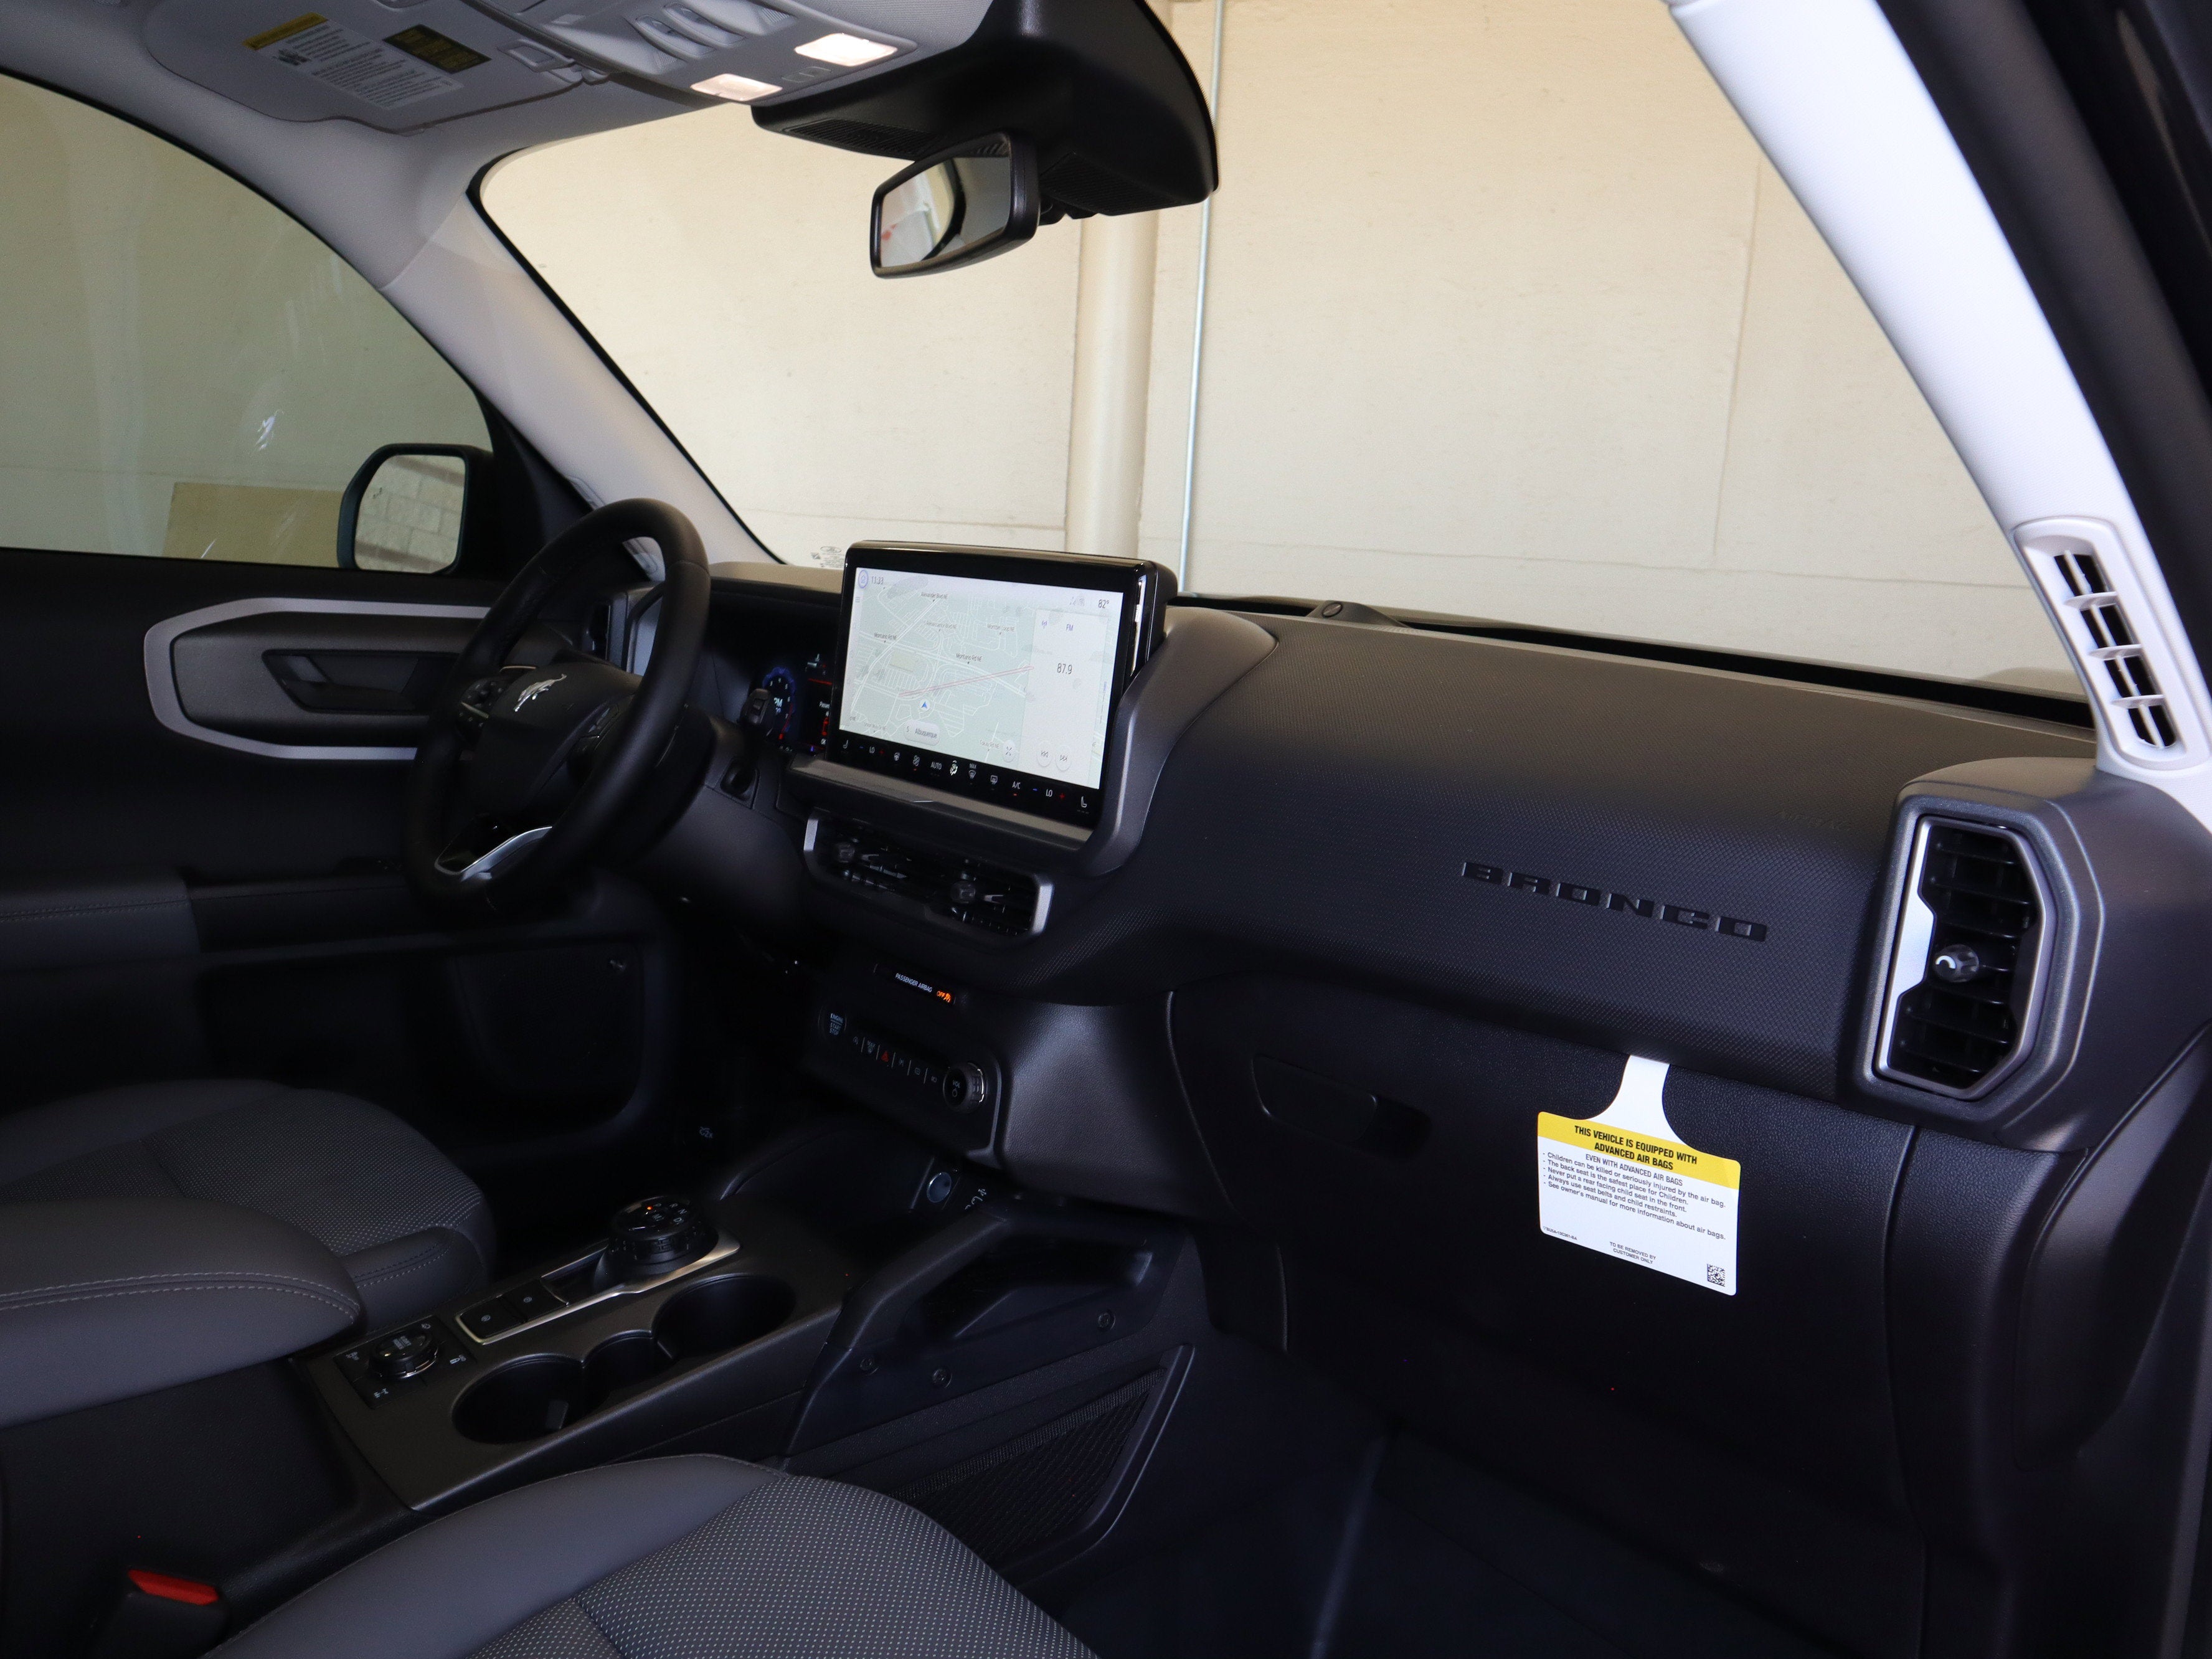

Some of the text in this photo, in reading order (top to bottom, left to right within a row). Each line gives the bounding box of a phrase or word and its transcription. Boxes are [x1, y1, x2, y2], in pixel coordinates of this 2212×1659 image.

[1066, 623, 1074, 631] FM
[1056, 662, 1073, 675] 87.9
[930, 762, 942, 770] AUTO
[1011, 781, 1021, 791] A/C
[1046, 788, 1053, 798] LO
[1462, 862, 1767, 942] BRONCO
[895, 973, 919, 987] PASSENGER
[937, 990, 946, 999] OFF
[1574, 1125, 1698, 1165] THIS VEHICLE IS EQUIPPED WITH
[1594, 1142, 1673, 1170] ADVANCED AIR BAGS
[1547, 1151, 1573, 1165] Children
[1574, 1160, 1586, 1168] can
[1586, 1163, 1595, 1171] be
[1595, 1165, 1613, 1176] killed
[1622, 1174, 1652, 1188] seriously
[1653, 1182, 1676, 1194] injured
[1678, 1188, 1686, 1198] by
[1688, 1191, 1699, 1200] the
[1711, 1198, 1726, 1208] bag.
[1547, 1158, 1559, 1168] The
[1560, 1163, 1575, 1173] back
[1576, 1168, 1589, 1176] seat
[1597, 1173, 1607, 1181] the
[1609, 1178, 1628, 1188] safest
[1629, 1183, 1647, 1193] place
[1648, 1188, 1658, 1196] for
[1658, 1191, 1688, 1205] Children.
[1586, 1153, 1683, 1186] EVEN WITH ADVANCED AIR BAGS
[1548, 1166, 1566, 1176] Never
[1582, 1178, 1595, 1186] rear
[1596, 1181, 1616, 1193] facing
[1617, 1188, 1633, 1197] child
[1634, 1193, 1648, 1201] seat
[1657, 1199, 1668, 1207] the
[1669, 1202, 1687, 1212] front.
[1548, 1174, 1570, 1186] Always
[1582, 1185, 1596, 1194] seat
[1597, 1188, 1613, 1198] belts
[1614, 1194, 1626, 1203] and
[1627, 1198, 1643, 1208] child
[1644, 1203, 1678, 1217] restraints.
[1548, 1181, 1560, 1189] See
[1560, 1186, 1584, 1197] owner's
[1585, 1193, 1608, 1204] manual
[1609, 1199, 1619, 1208] for
[1619, 1203, 1636, 1213] more
[1637, 1208, 1675, 1224] information
[1676, 1221, 1695, 1231] about
[1707, 1229, 1726, 1240] bags.
[1612, 1248, 1640, 1260] CUSTOMER
[1624, 1246, 1648, 1258] REMOVED
